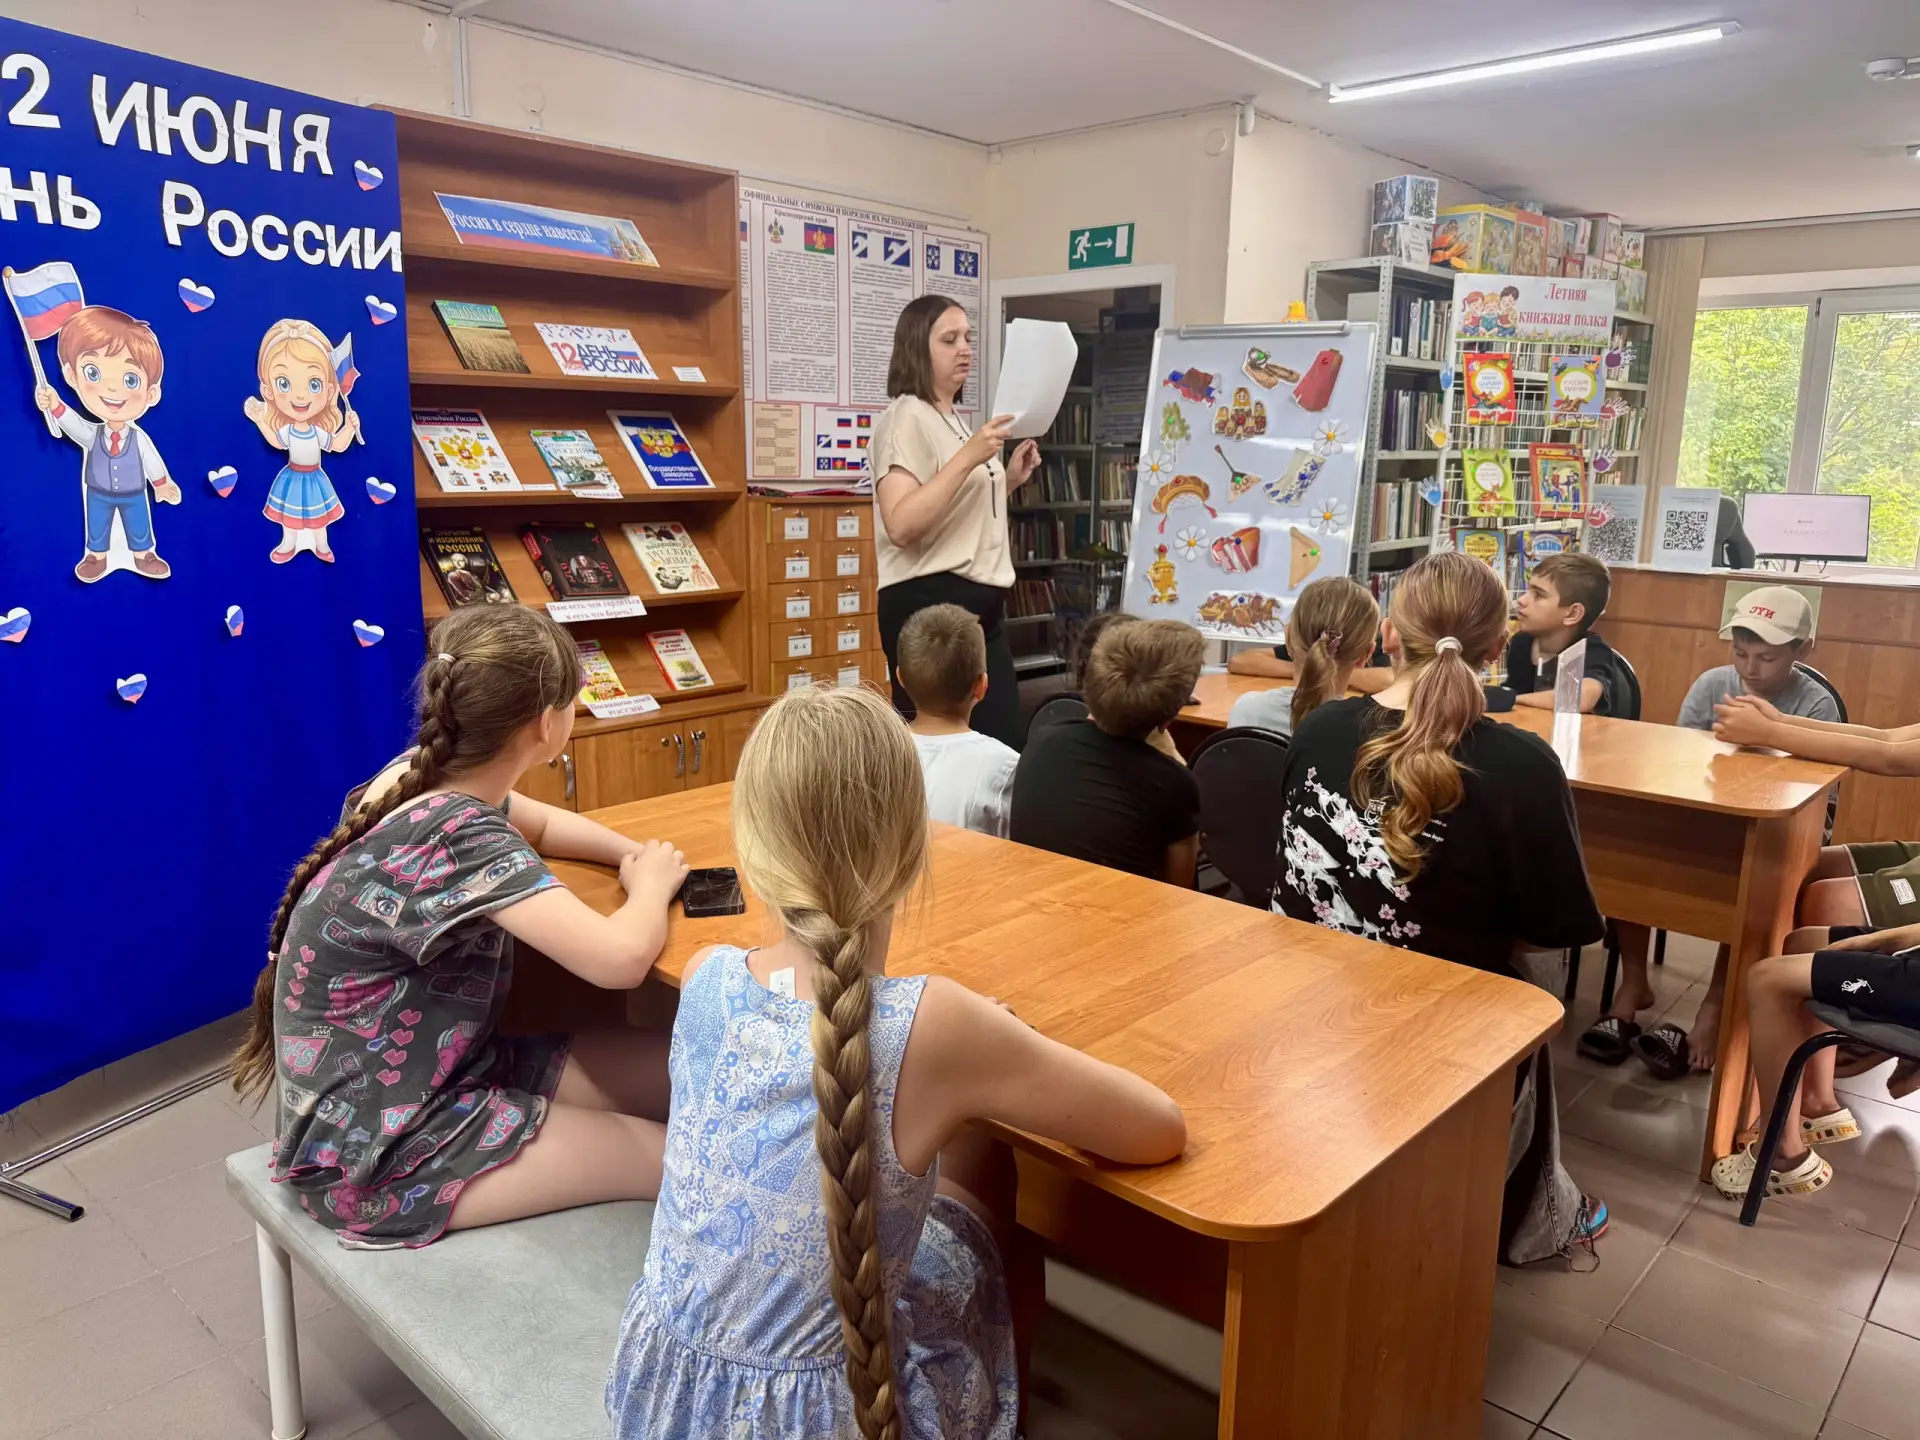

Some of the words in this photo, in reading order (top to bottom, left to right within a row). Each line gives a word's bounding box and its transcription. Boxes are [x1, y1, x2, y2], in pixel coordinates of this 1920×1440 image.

[92, 74, 333, 175] ИЮНЯ
[744, 190, 799, 207] ОФИЦИАЛЬНЫЕ
[445, 207, 492, 231] Россия
[493, 219, 502, 232] в
[503, 220, 542, 239] сердце
[543, 225, 597, 244] навсегда!
[1545, 284, 1588, 302] Летняя
[1519, 310, 1570, 327] книжная
[1574, 315, 1608, 328] полка
[551, 342, 584, 364] 12
[576, 343, 619, 359] ДЕНЬ
[581, 358, 650, 375] РОССИИ
[438, 544, 483, 553] РОССИИ
[482, 1106, 523, 1146] YES
